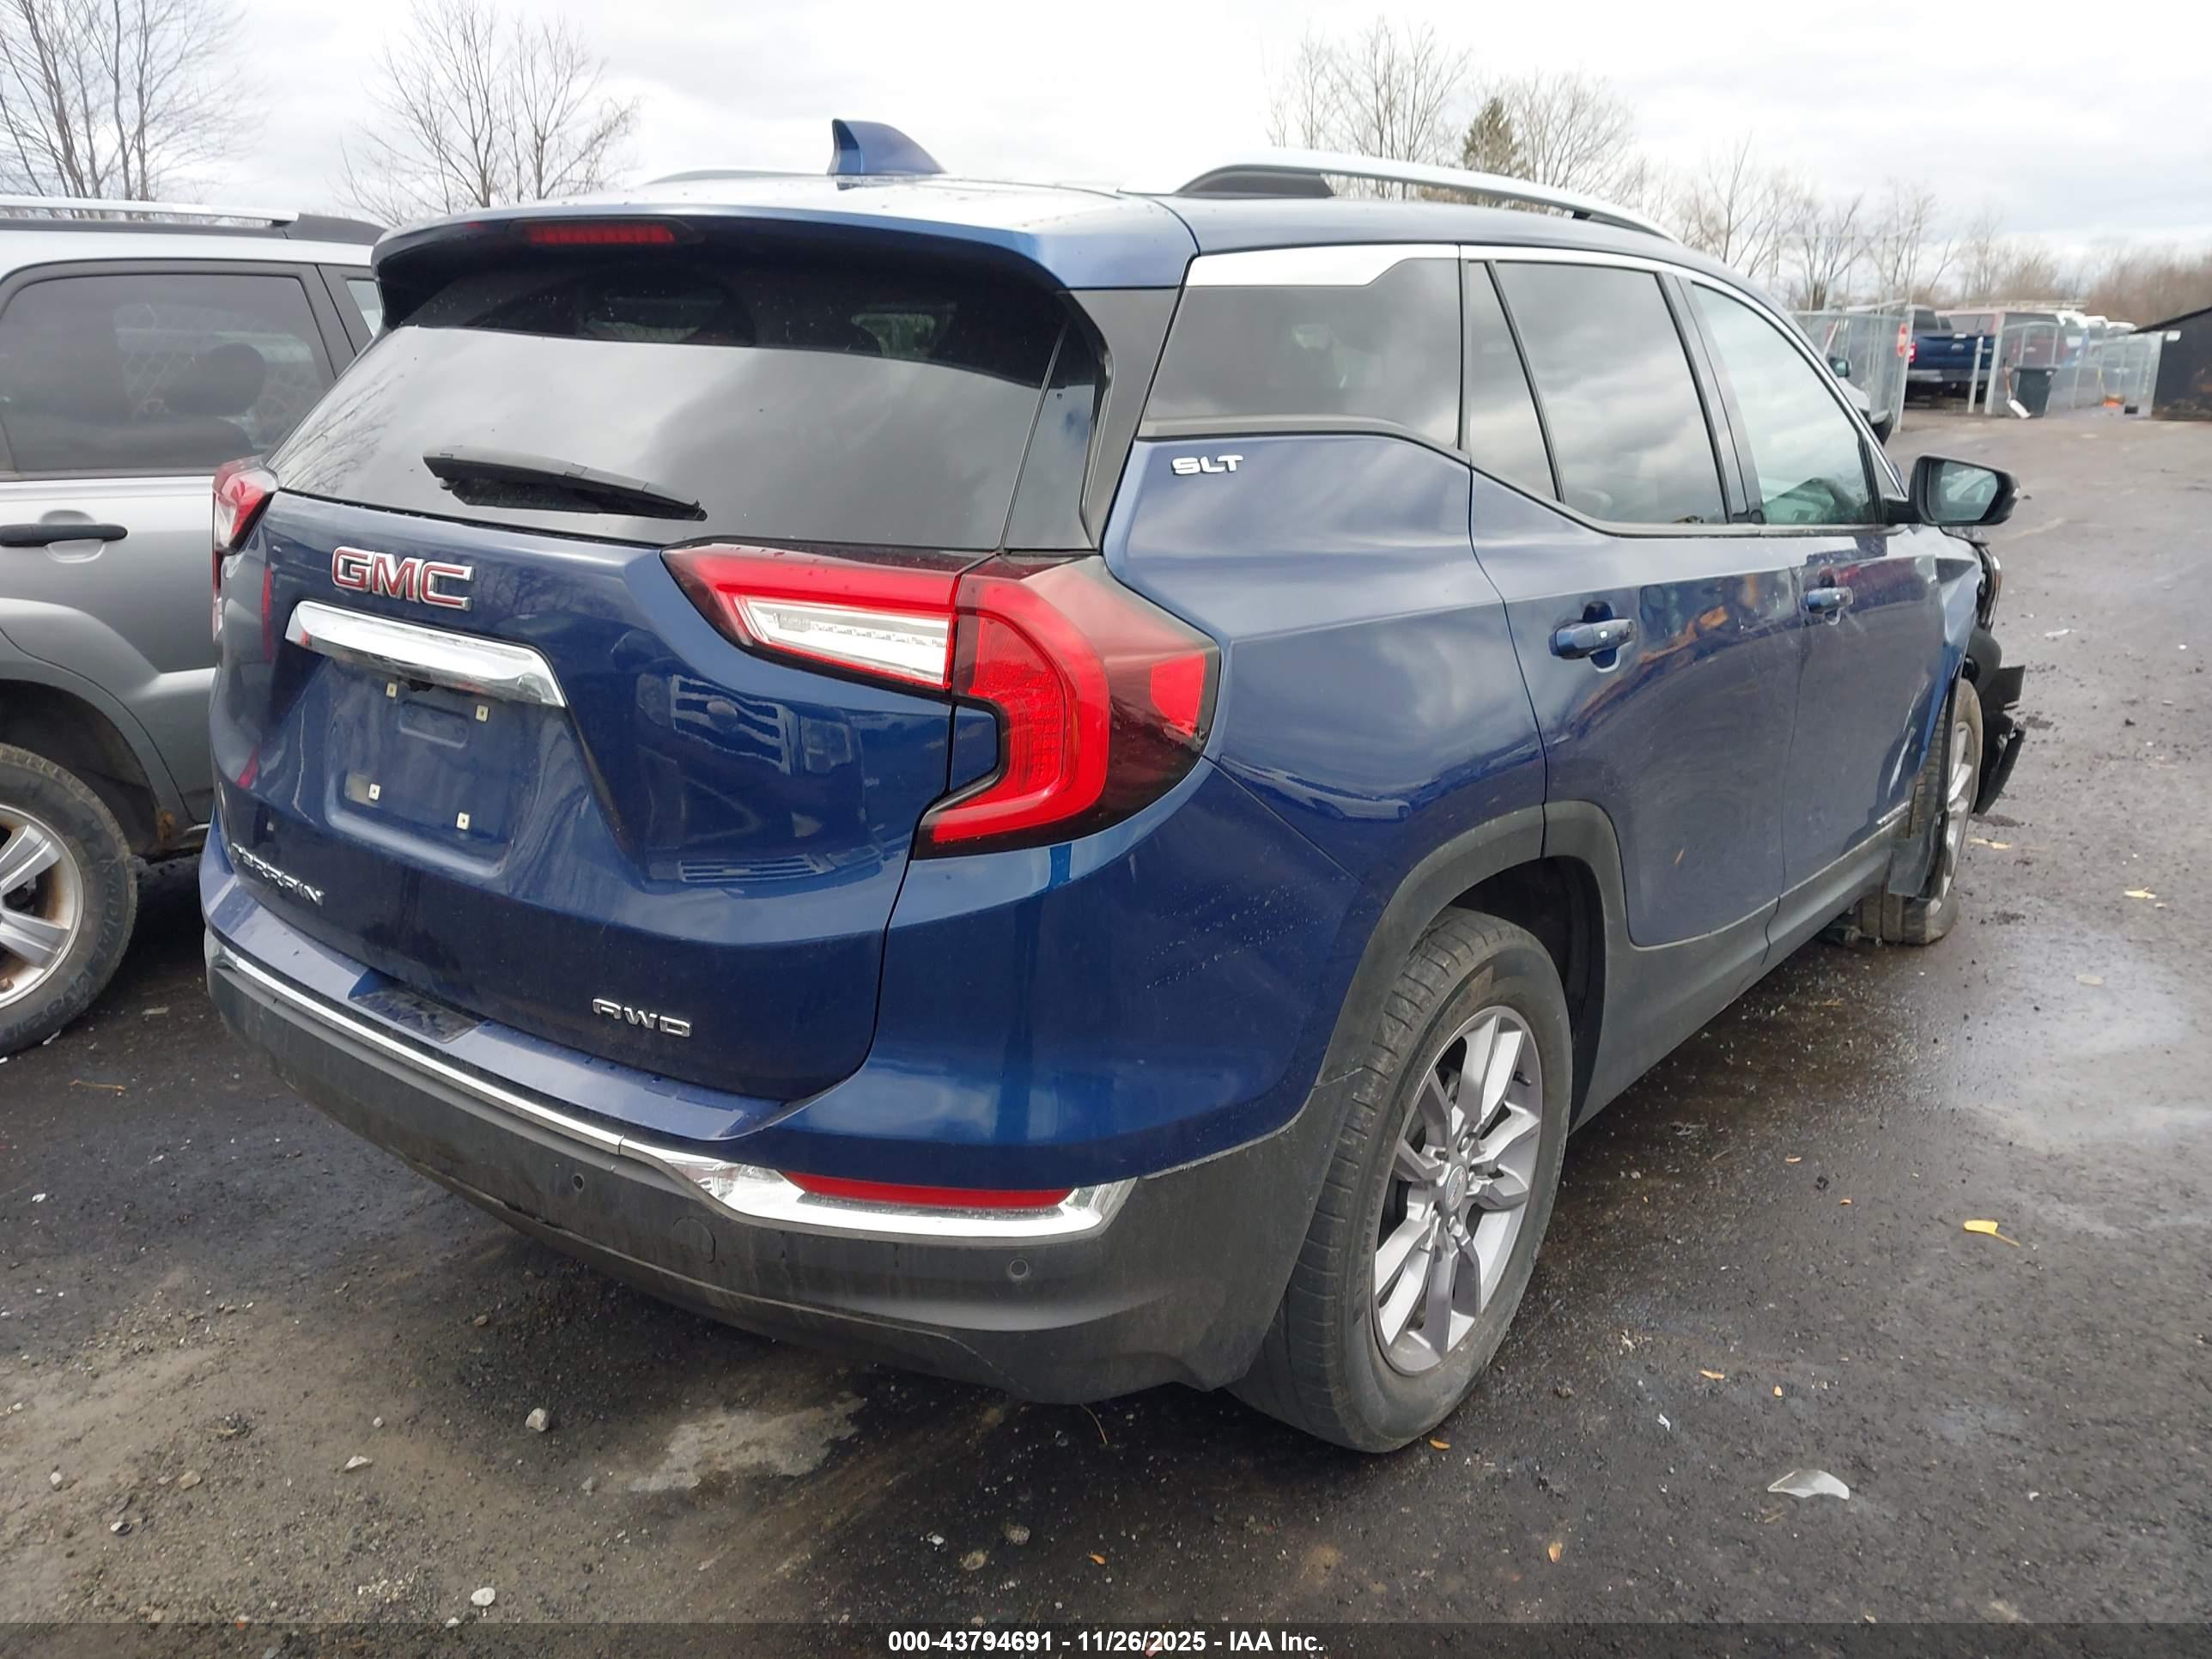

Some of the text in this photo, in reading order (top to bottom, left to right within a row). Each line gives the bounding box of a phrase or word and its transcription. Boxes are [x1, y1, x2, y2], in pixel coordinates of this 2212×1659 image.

[1172, 454, 1244, 475] SLT
[331, 545, 473, 611] GMC
[592, 998, 691, 1038] AWD
